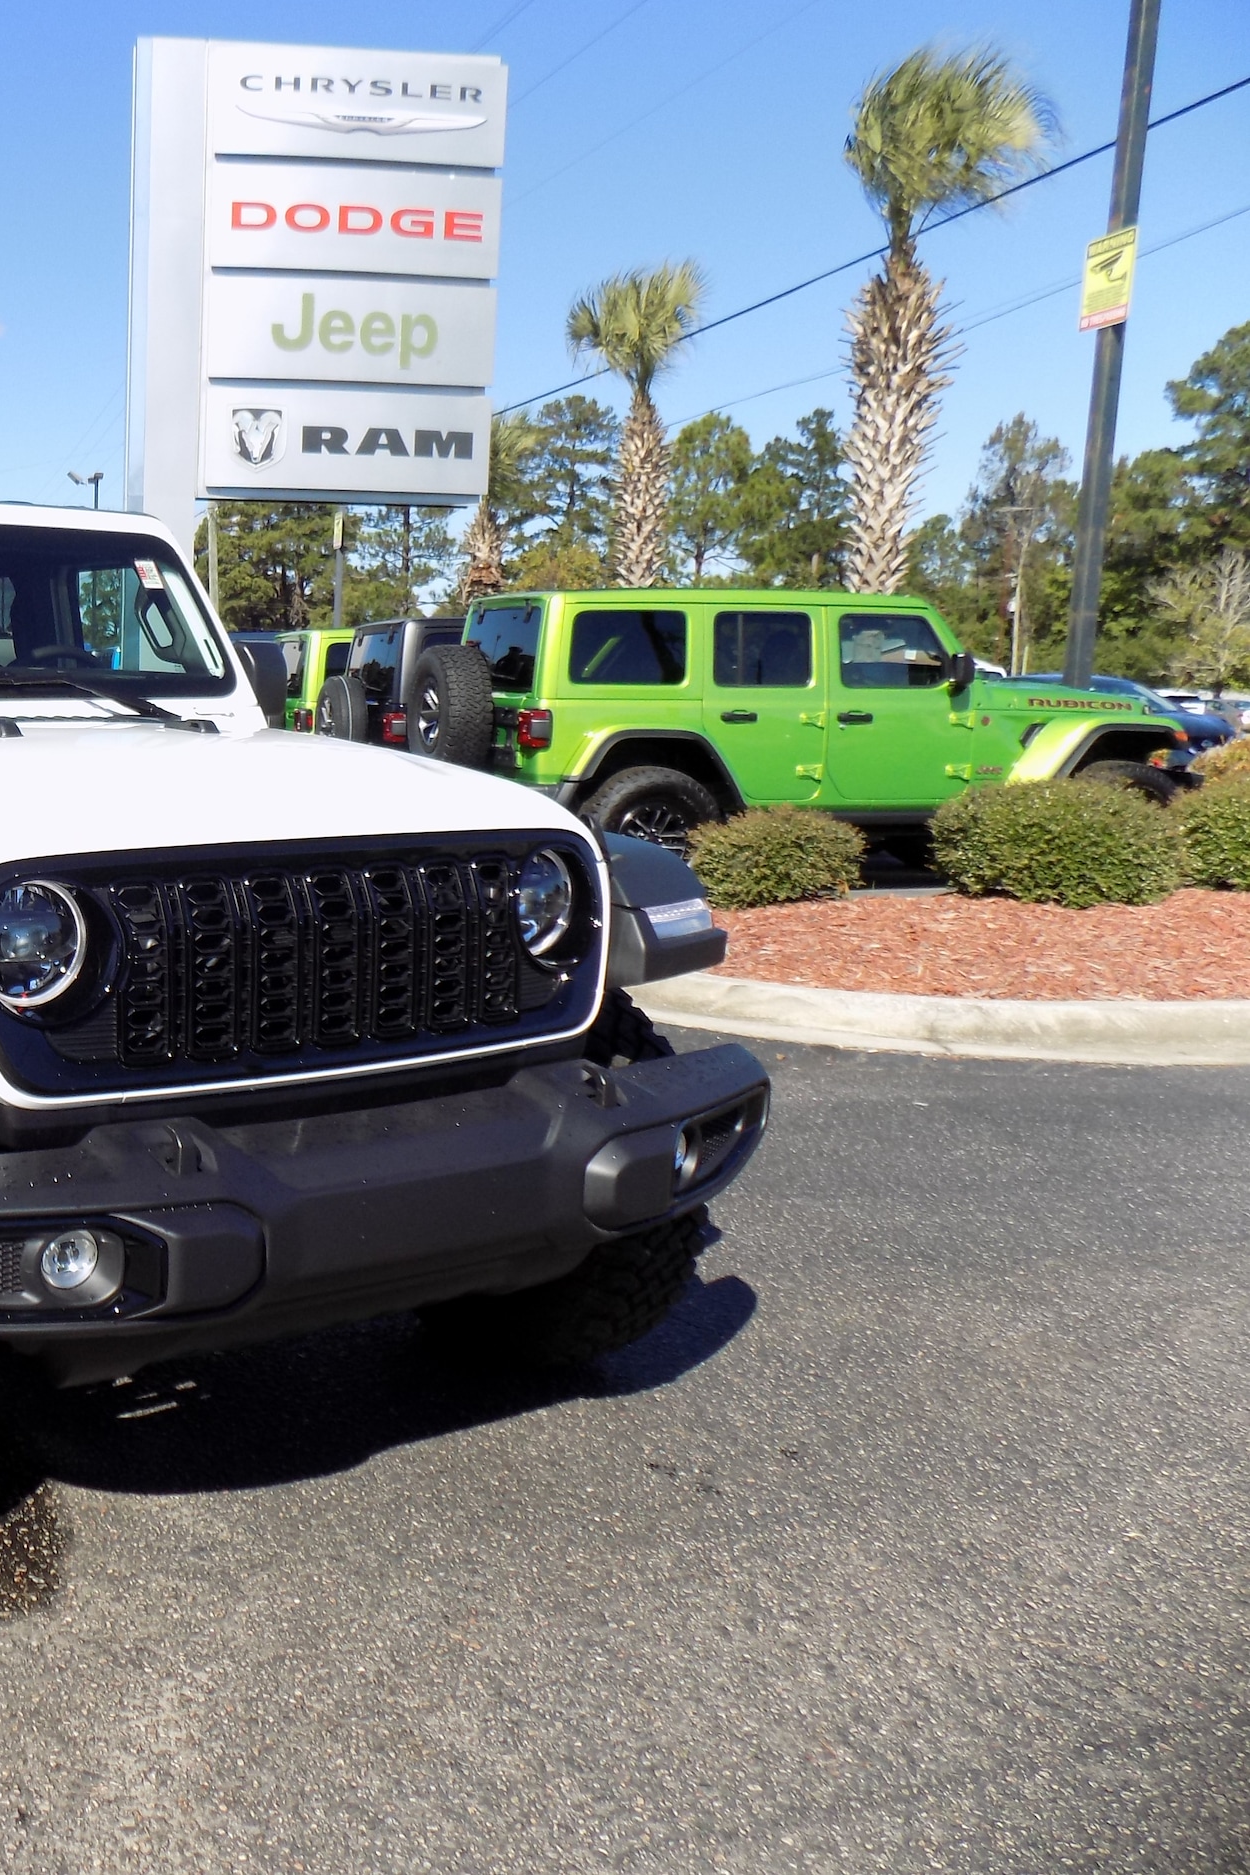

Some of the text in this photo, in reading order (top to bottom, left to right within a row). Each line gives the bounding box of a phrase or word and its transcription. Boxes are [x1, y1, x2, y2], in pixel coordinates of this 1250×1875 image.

[239, 74, 483, 103] CHRYSLER
[231, 201, 484, 243] DODGE
[271, 293, 439, 369] Jeep
[301, 425, 474, 459] RAM
[1027, 698, 1133, 711] RUBICON
